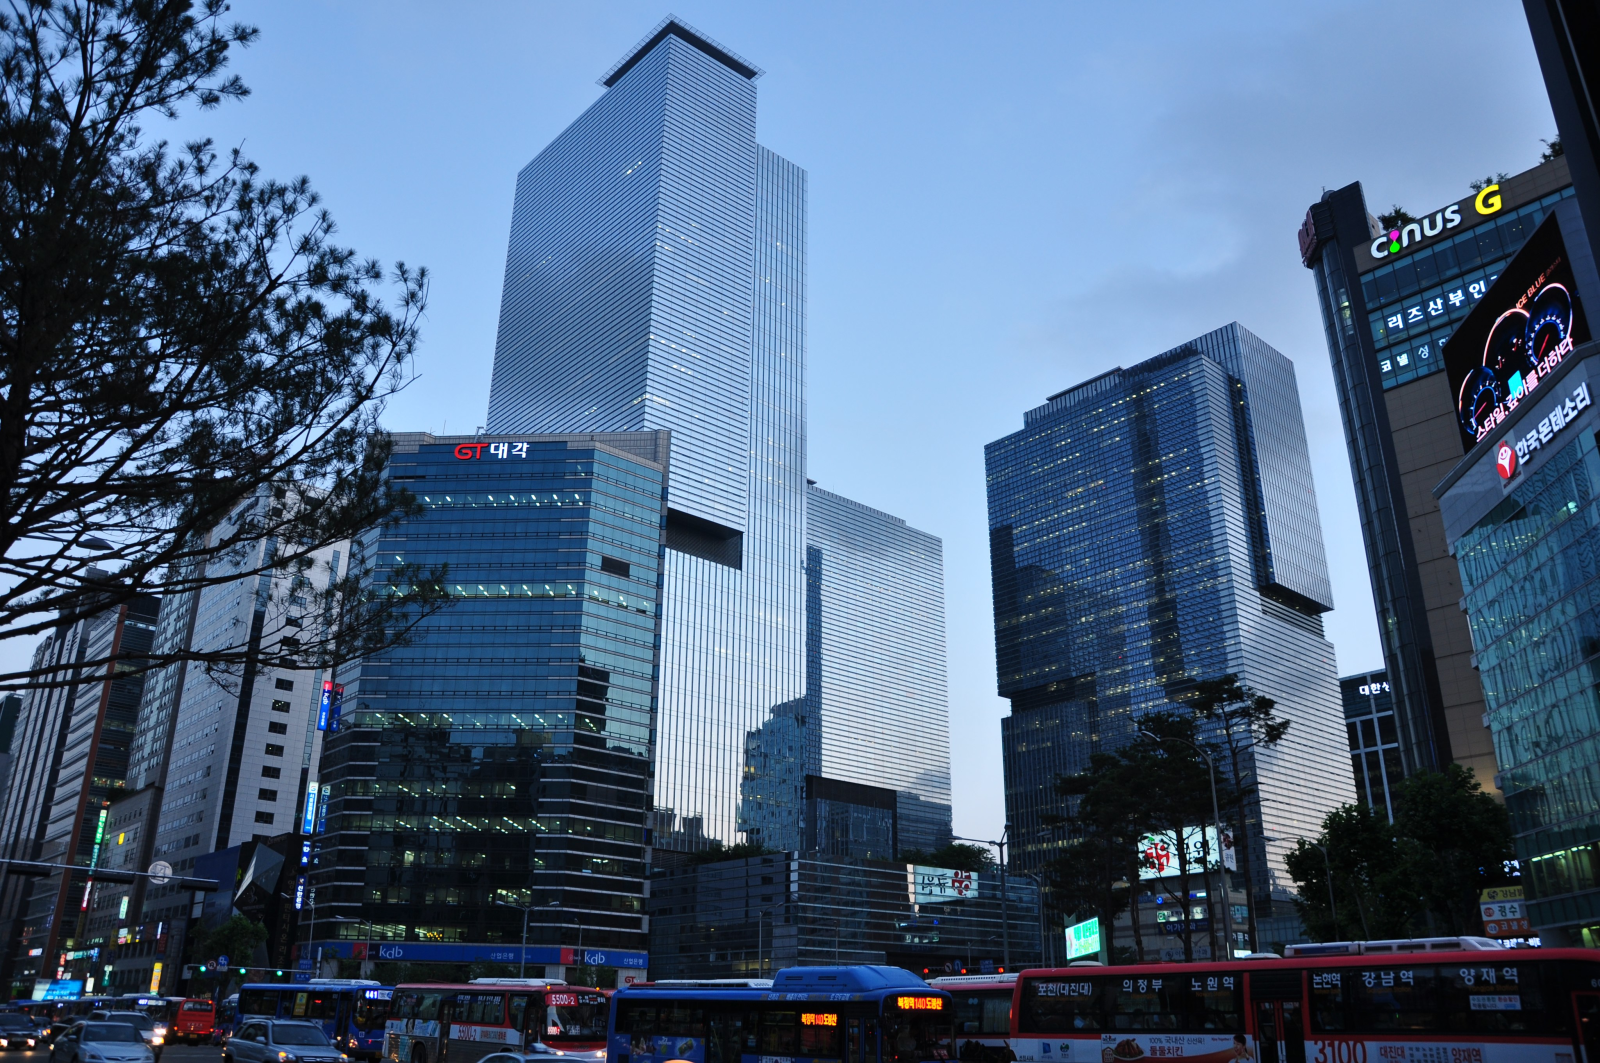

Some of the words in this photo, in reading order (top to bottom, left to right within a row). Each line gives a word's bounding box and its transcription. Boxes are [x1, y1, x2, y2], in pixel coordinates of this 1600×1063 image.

[1474, 184, 1503, 215] G
[1515, 293, 1528, 309] ICE
[1527, 272, 1546, 298] BLUE
[1387, 275, 1498, 329] 리즈산부인
[1514, 381, 1592, 465] 한국몬테소리
[454, 442, 489, 460] GT
[489, 442, 530, 459] 대각
[379, 945, 403, 959] kdb
[490, 952, 514, 960] 산업은행
[584, 951, 605, 965] kdb
[623, 957, 643, 966] 산업은행
[1191, 976, 1234, 991] 노원역
[1313, 973, 1341, 989] 논현역
[1362, 970, 1414, 988] 강남역
[1459, 967, 1519, 985] 양재역
[1038, 982, 1092, 997] 포천(대진대)
[1122, 979, 1163, 993] 의정부
[365, 990, 378, 999] 441
[551, 994, 575, 1006] 5500-2
[915, 997, 926, 1009] 140
[926, 997, 942, 1010] 도봉산
[823, 1013, 837, 1026] 도봉산
[1149, 1037, 1163, 1045] 100%
[1165, 1035, 1185, 1045] 국내산
[1150, 1046, 1183, 1057] 둘둘치킨
[1314, 1040, 1367, 1063] 3100
[1379, 1045, 1406, 1059] 대진대
